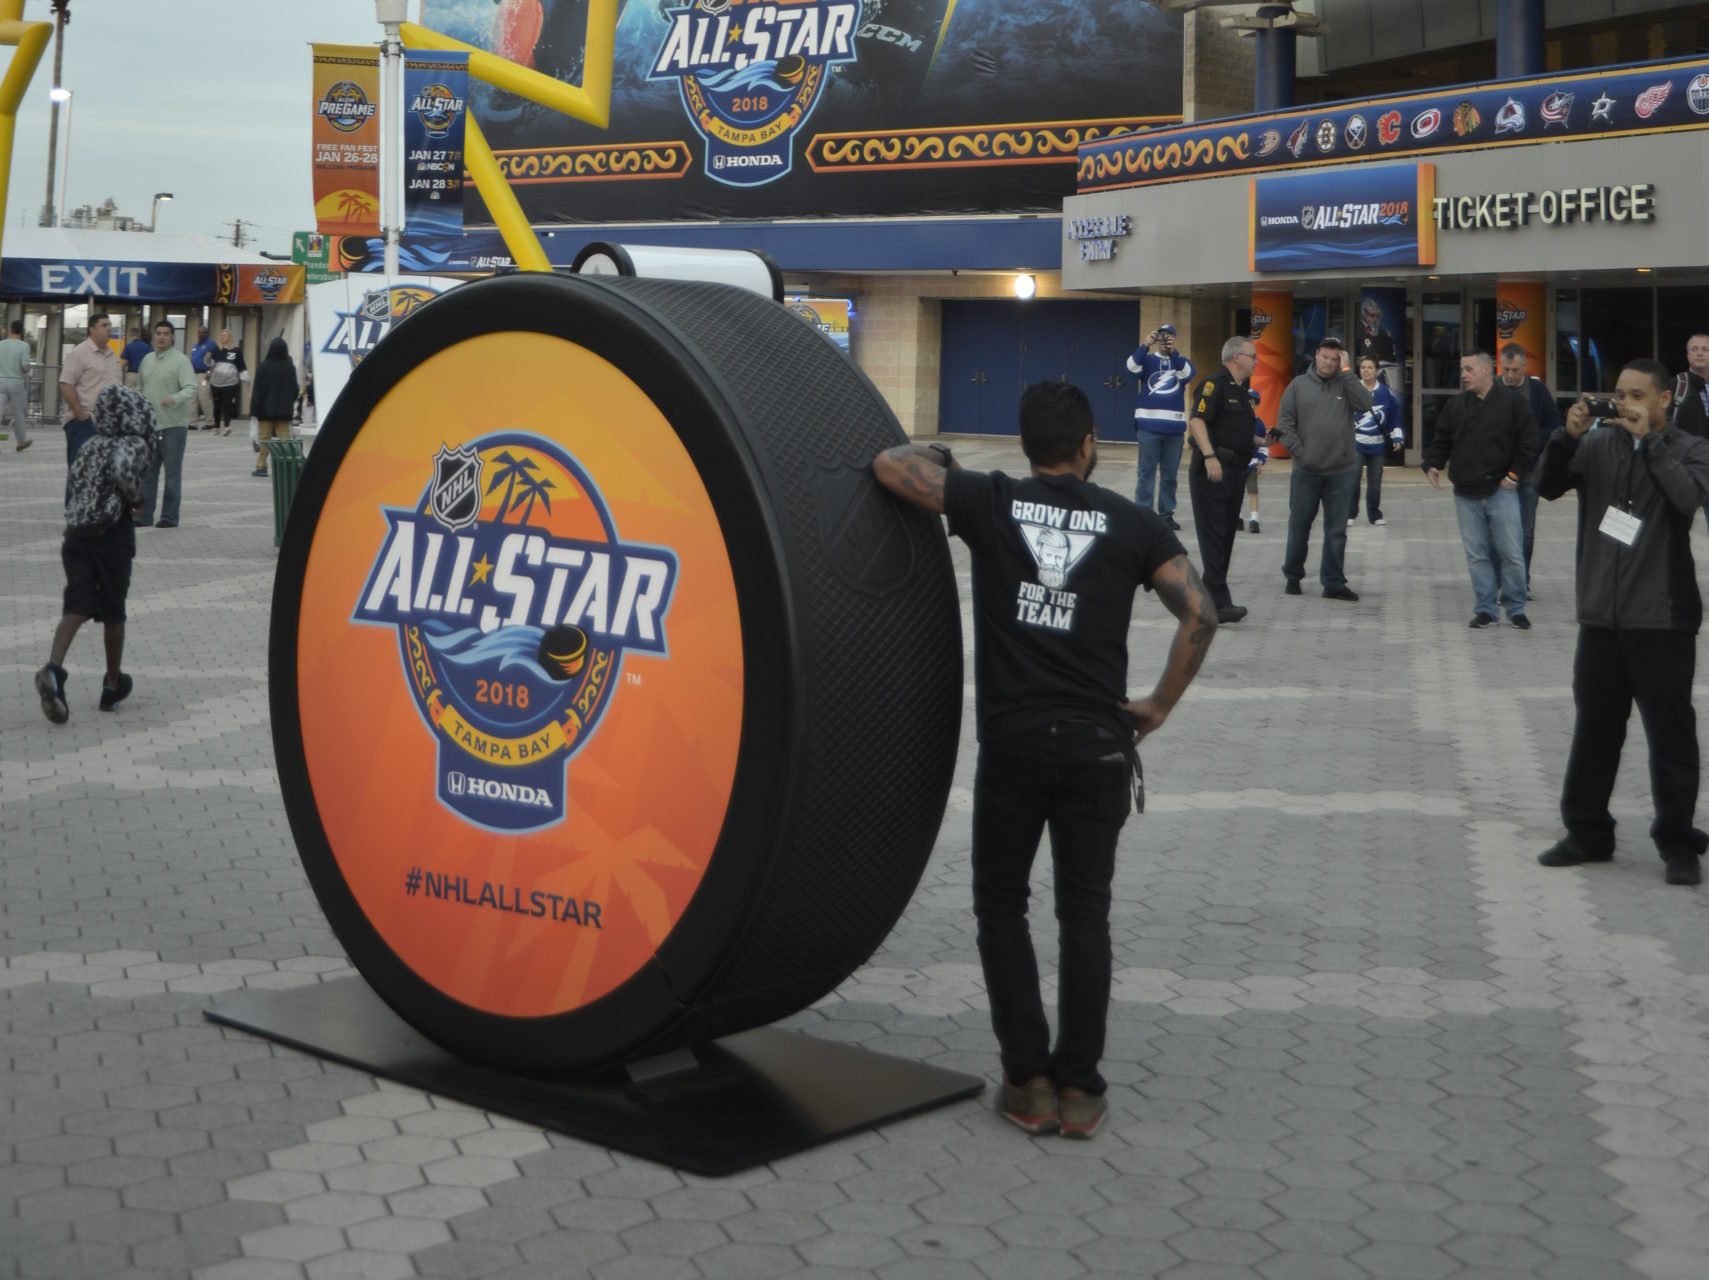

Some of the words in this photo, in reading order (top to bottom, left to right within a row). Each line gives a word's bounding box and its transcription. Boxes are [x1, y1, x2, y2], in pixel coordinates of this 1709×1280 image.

[856, 23, 922, 53] CCM
[319, 102, 376, 116] PREGAME
[732, 96, 768, 111] 2018
[717, 125, 756, 142] TAMPA
[760, 121, 783, 141] BAY
[315, 152, 341, 162] JAN
[344, 152, 378, 163] 26-28
[316, 143, 338, 151] FREE
[340, 144, 356, 152] FAN
[408, 150, 431, 160] JAN
[432, 150, 446, 160] 27
[427, 163, 455, 172] NBCSN
[726, 155, 783, 167] HONDA
[408, 179, 430, 189] JAN
[432, 179, 446, 189] 28
[1268, 216, 1299, 225] HONDA
[1379, 201, 1408, 216] 2018
[1433, 192, 1529, 230] TICKET
[1539, 184, 1649, 224] OFFICE
[1081, 239, 1113, 261] ENTRY
[40, 265, 147, 297] EXIT
[369, 298, 387, 314] NHL
[440, 467, 473, 508] NHL
[1011, 499, 1067, 528] GROW
[1069, 510, 1107, 533] ONE
[1018, 581, 1046, 602] FOR
[1049, 590, 1077, 609] THE
[1016, 598, 1074, 631] TEAM
[626, 673, 642, 685] TM
[476, 679, 530, 709] 2018
[452, 721, 513, 760] TAMPA
[518, 733, 552, 760] BAY
[467, 777, 553, 808] HONDA
[405, 866, 602, 929] #NHLALLSTAR
